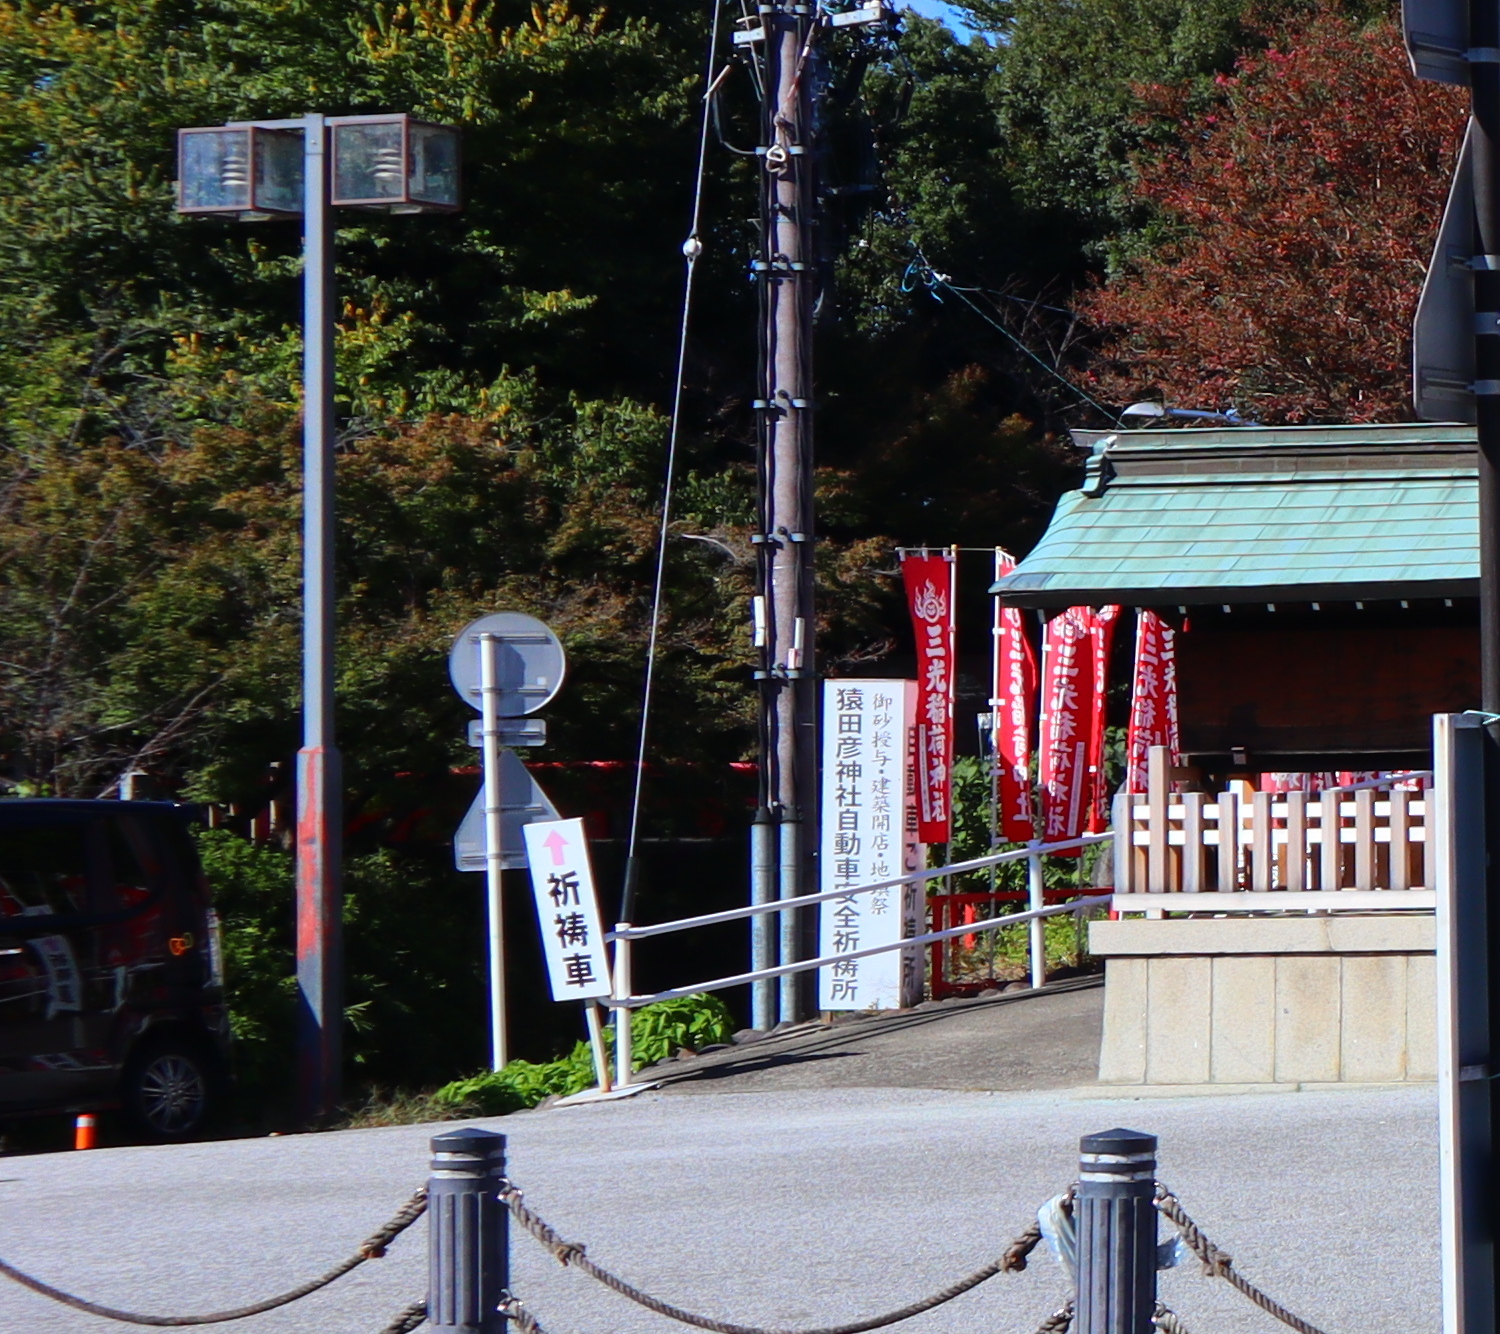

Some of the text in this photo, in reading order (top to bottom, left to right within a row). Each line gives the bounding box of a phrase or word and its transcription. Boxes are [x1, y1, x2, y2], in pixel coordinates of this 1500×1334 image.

[925, 624, 946, 822] 三光稲荷神社
[547, 870, 598, 988] 祈祷車
